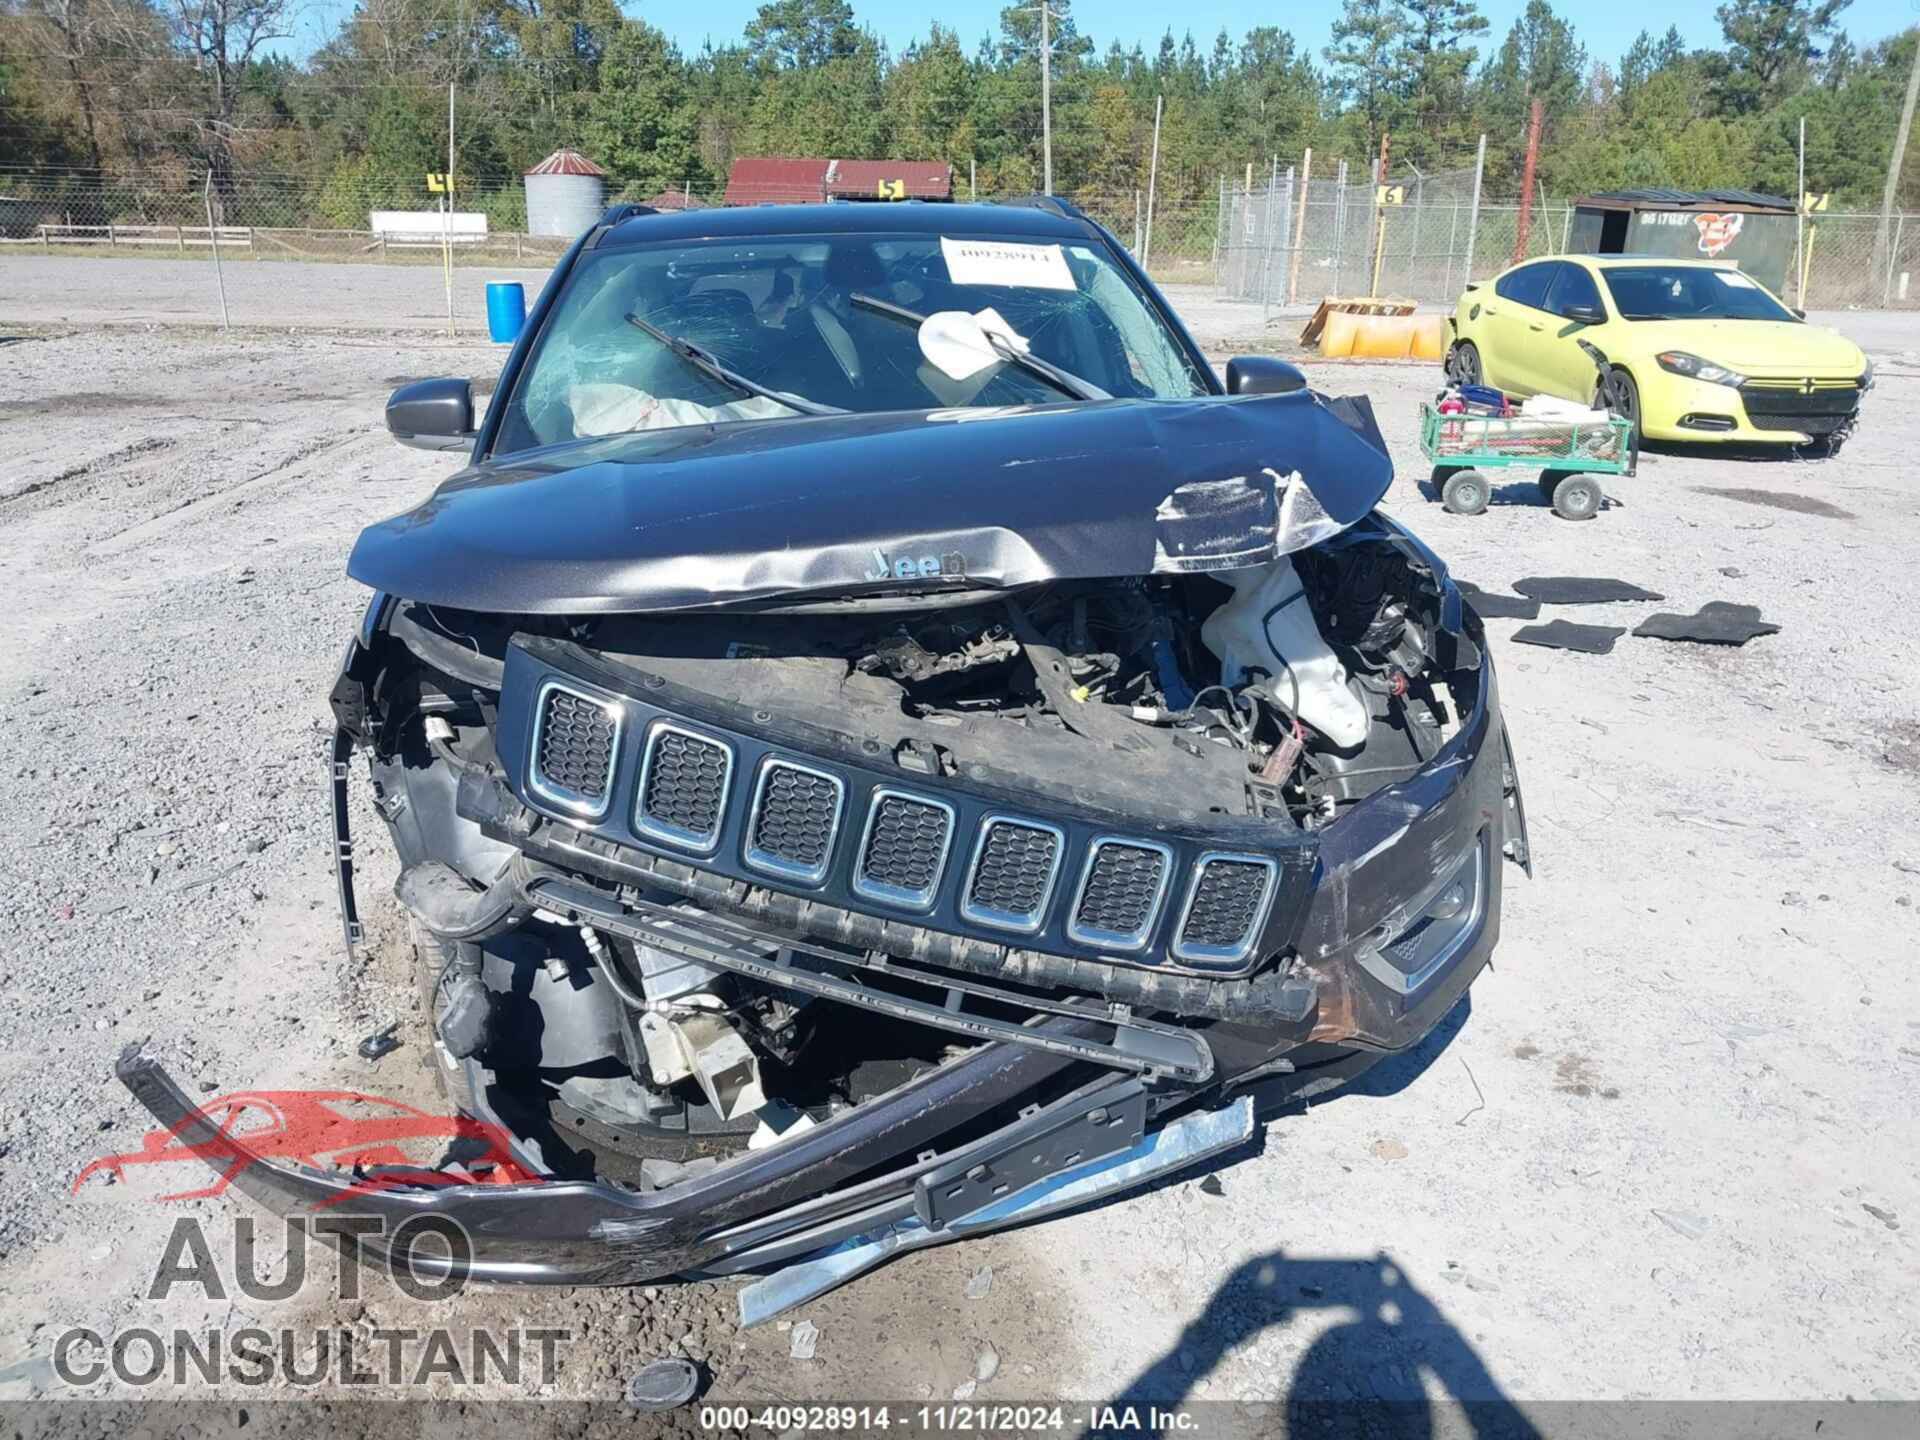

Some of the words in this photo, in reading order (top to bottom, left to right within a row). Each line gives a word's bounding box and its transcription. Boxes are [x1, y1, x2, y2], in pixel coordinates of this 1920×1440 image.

[435, 173, 449, 192] 4
[884, 179, 896, 196] 5
[1384, 185, 1398, 203] 6
